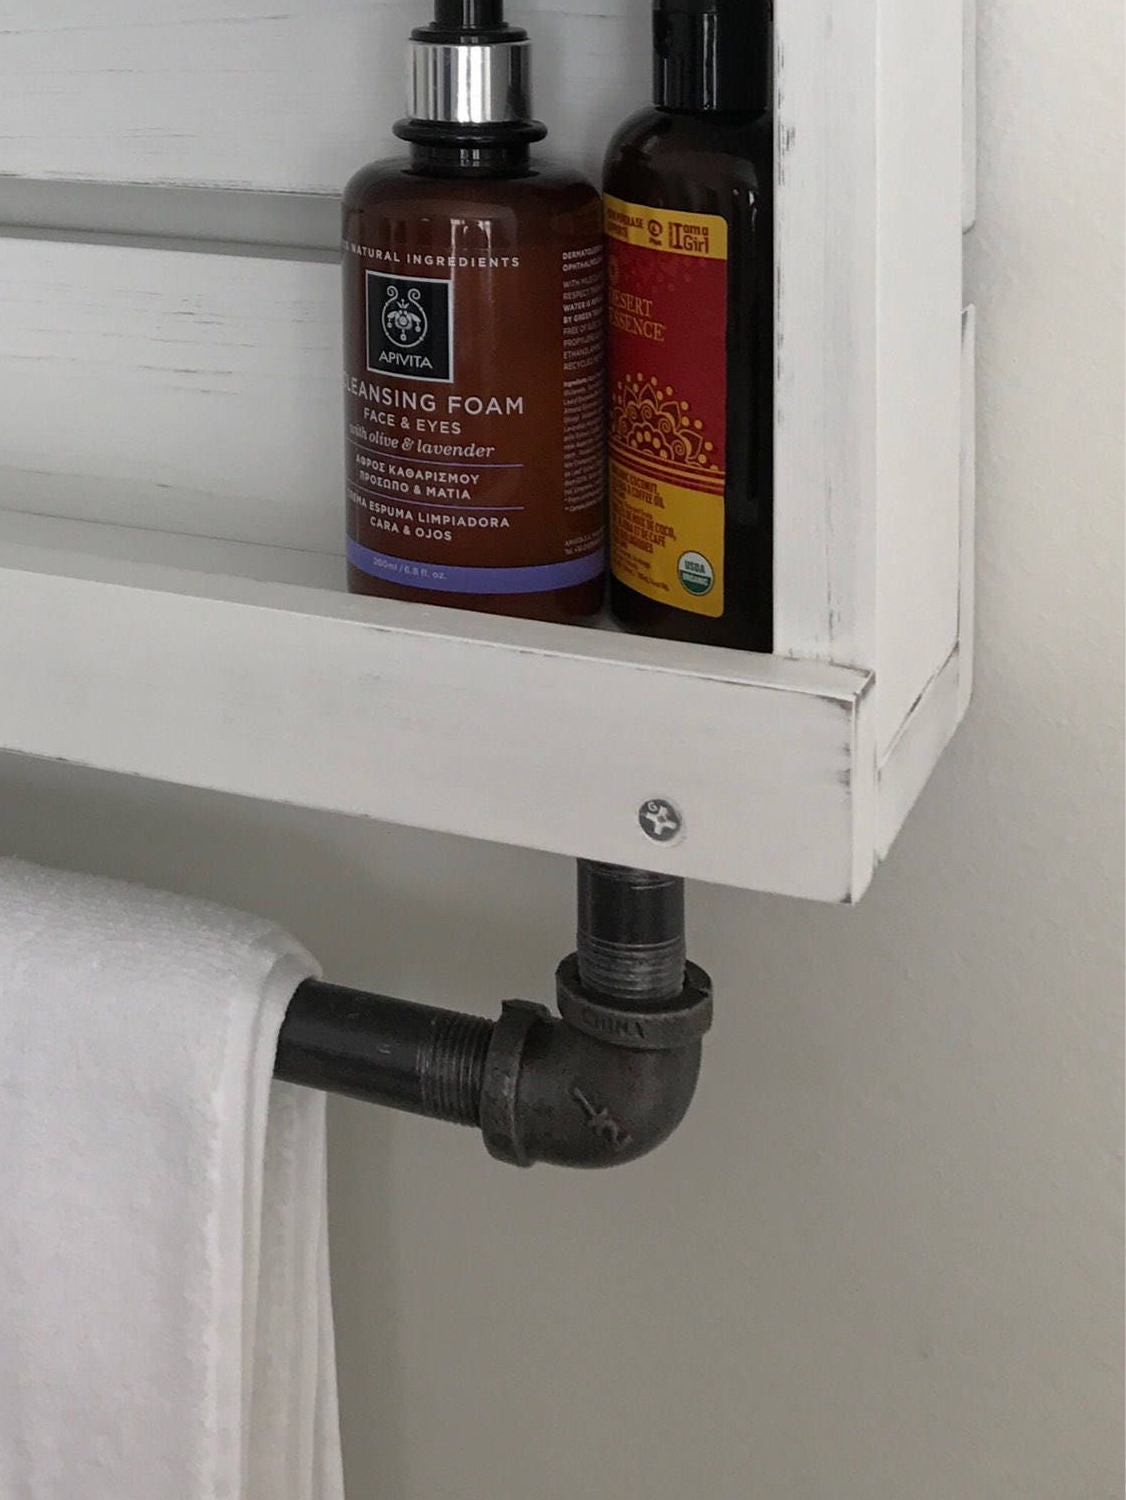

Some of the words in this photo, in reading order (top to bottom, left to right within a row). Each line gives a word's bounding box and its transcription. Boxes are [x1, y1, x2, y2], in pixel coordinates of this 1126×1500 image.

[351, 245, 400, 263] NATURAL
[406, 253, 520, 269] INGREDIENTS
[683, 235, 709, 253] Girl
[378, 350, 433, 369] APIVITA
[345, 377, 436, 413] LEANSING
[448, 396, 523, 415] FOAM
[364, 407, 395, 427] FACE
[400, 416, 410, 430] &
[416, 419, 462, 435] EYES
[369, 430, 398, 449] olive
[402, 435, 414, 451] &
[417, 440, 495, 459] lavender
[359, 470, 409, 493] ΠΡΟΣΩΠΟ
[413, 483, 422, 495] &
[426, 486, 471, 500] ΜΑΤΙΑ
[388, 462, 480, 485] ΚΑΘΑΡΙΣΜΟΥ
[369, 499, 414, 522] ESPUMA
[418, 508, 510, 528] LIMPIADORA
[370, 516, 399, 534] CARA
[403, 524, 412, 536] &
[415, 526, 452, 542] OJOS
